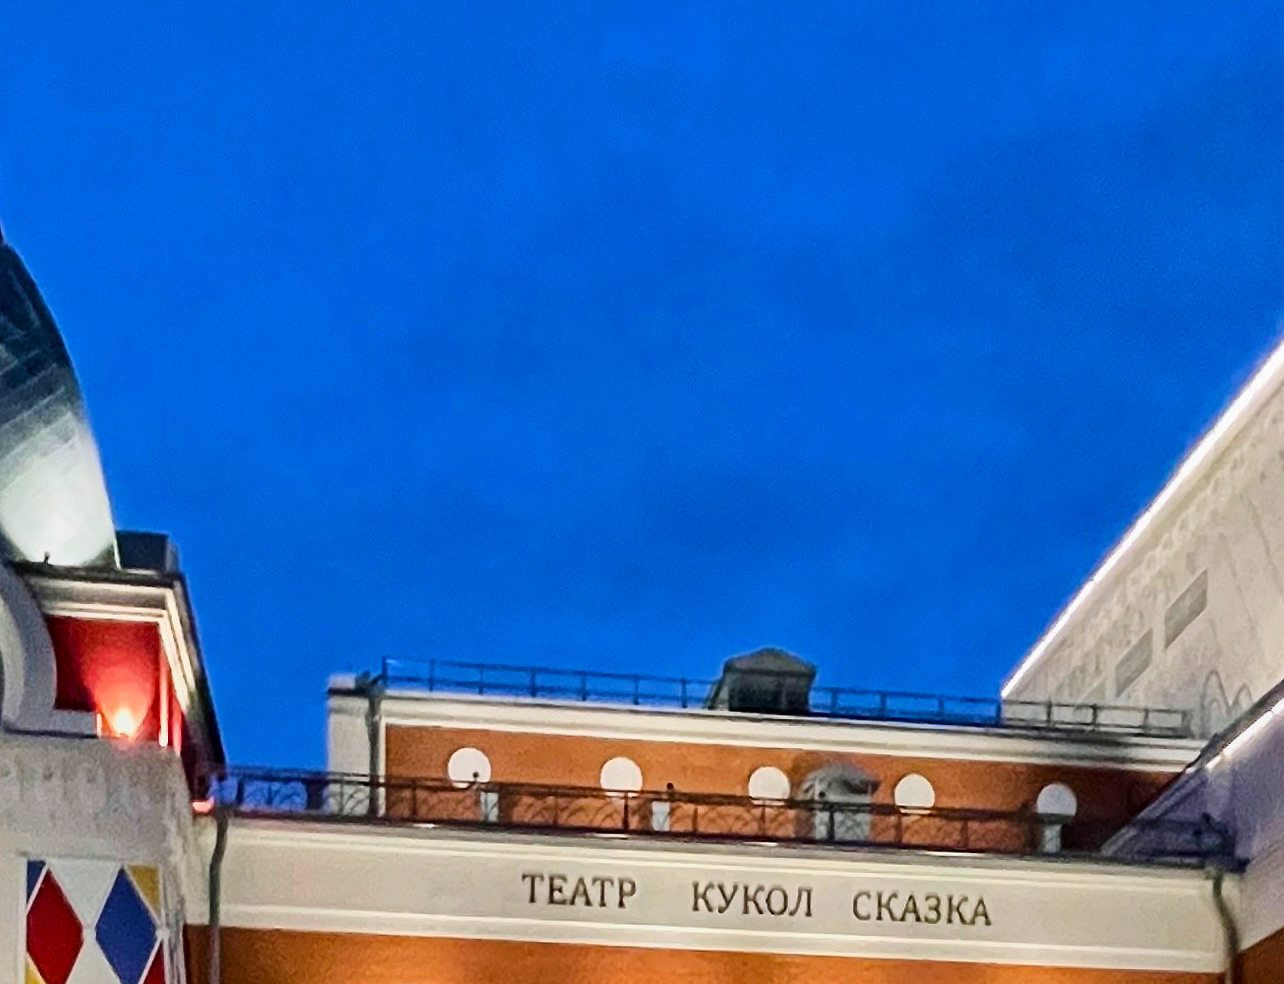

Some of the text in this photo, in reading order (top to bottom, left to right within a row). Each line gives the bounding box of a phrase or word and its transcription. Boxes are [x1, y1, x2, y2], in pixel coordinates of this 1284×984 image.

[521, 872, 993, 927] ТЕАТР КУКОЛ СКАЗКА
